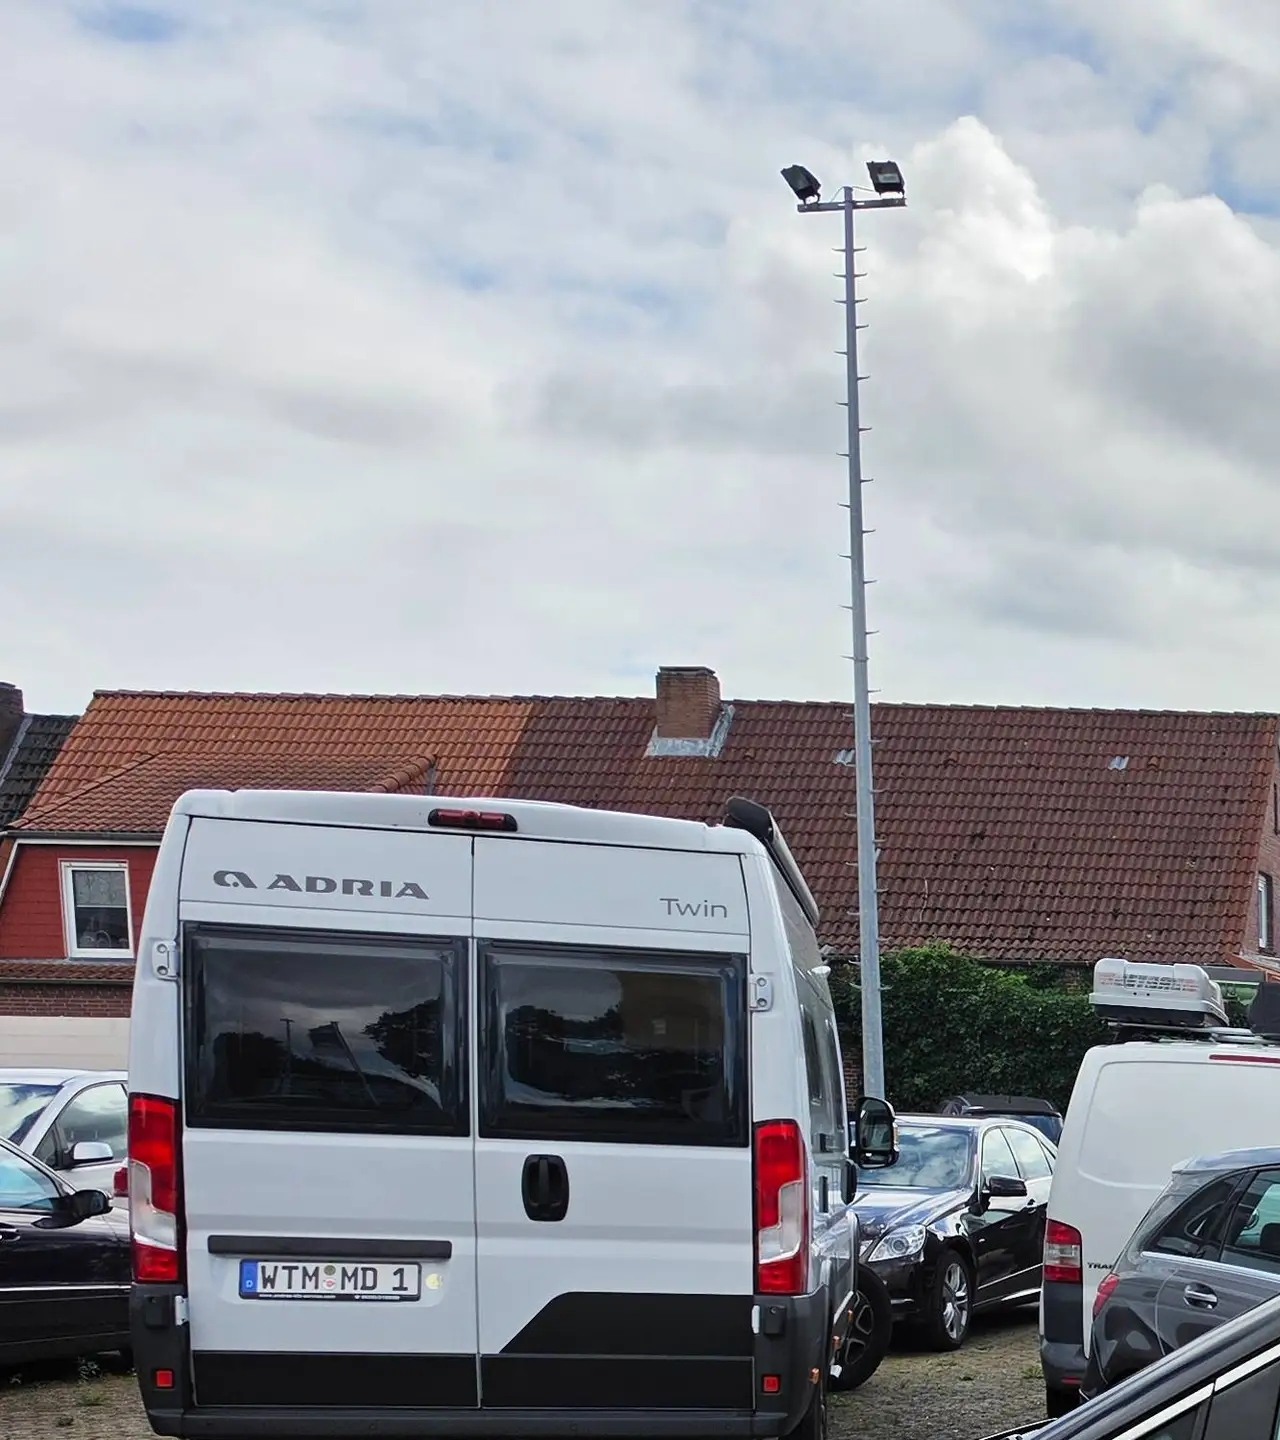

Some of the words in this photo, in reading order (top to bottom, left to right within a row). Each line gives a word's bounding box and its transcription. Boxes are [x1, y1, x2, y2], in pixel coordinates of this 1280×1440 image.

[266, 873, 430, 900] ADRIA
[659, 898, 727, 918] Twin
[259, 1265, 320, 1291] WTM
[340, 1266, 378, 1291] MD
[391, 1267, 409, 1292] 1
